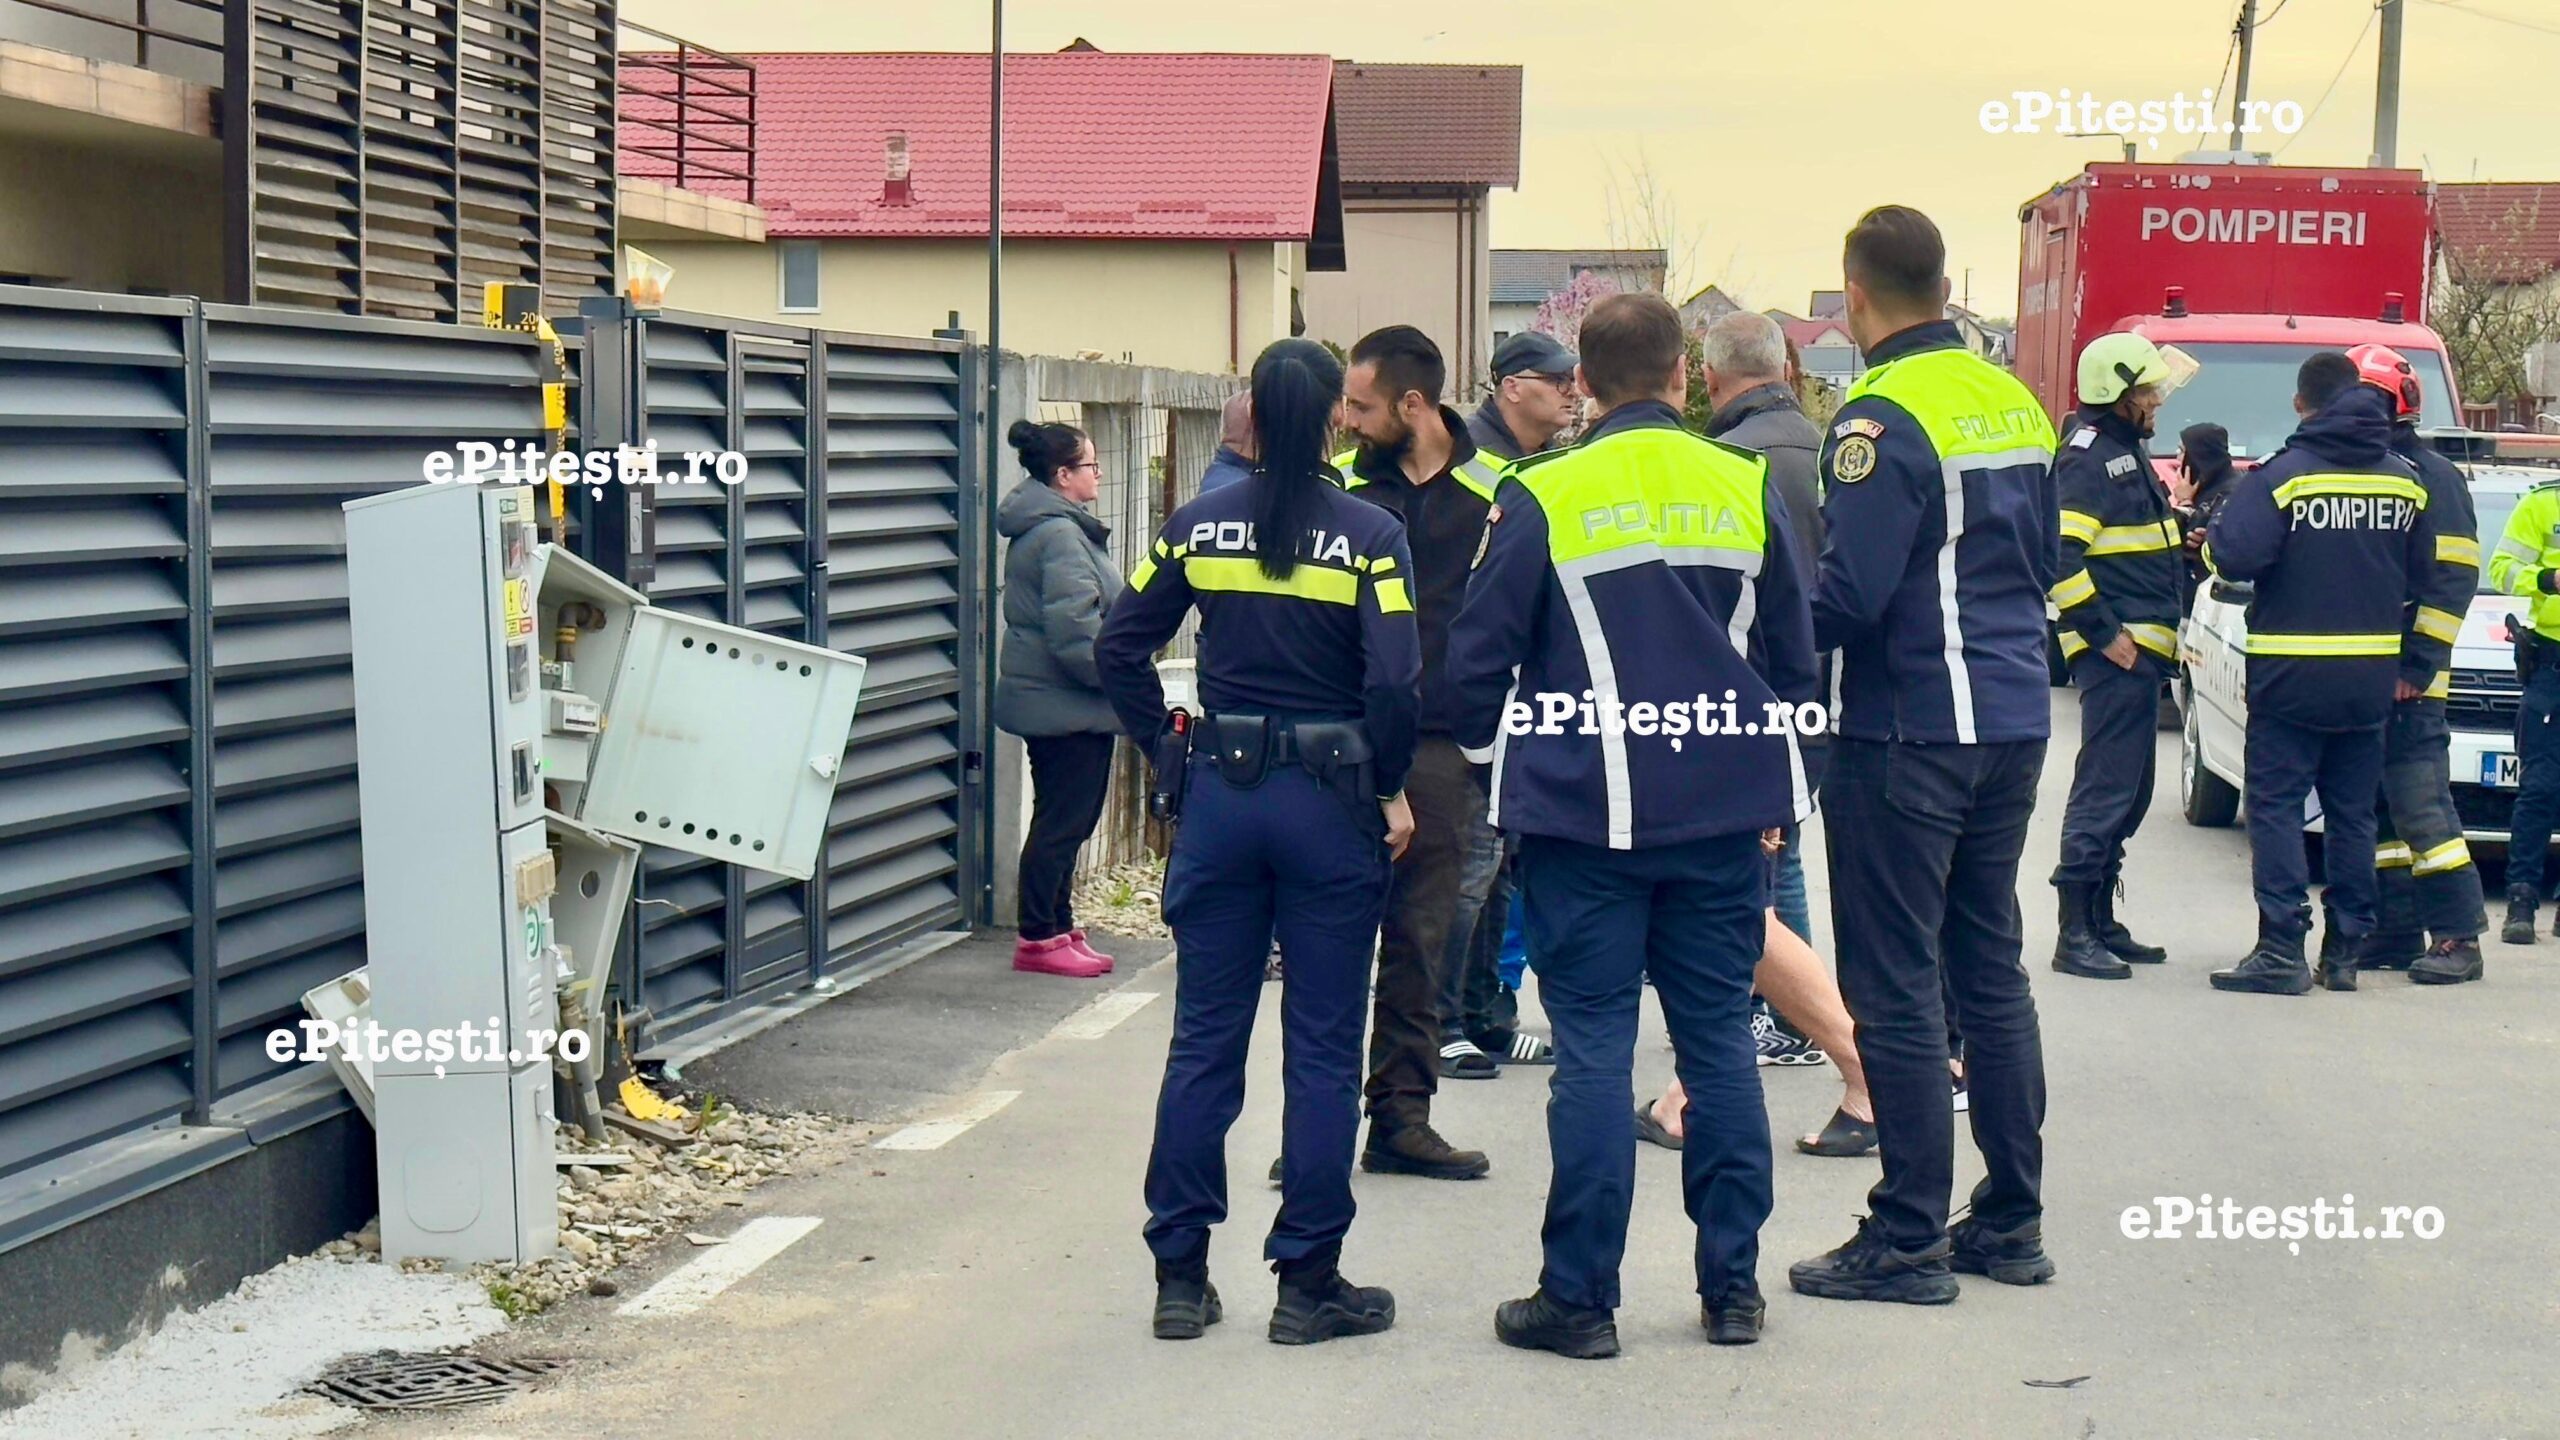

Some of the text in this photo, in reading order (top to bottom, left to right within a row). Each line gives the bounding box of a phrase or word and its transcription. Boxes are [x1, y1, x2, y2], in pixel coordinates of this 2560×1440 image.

[2141, 207, 2366, 247] POMPIERI
[520, 311, 536, 325] 20
[1189, 521, 1353, 567] POLIA
[2483, 758, 2518, 783] RO M
